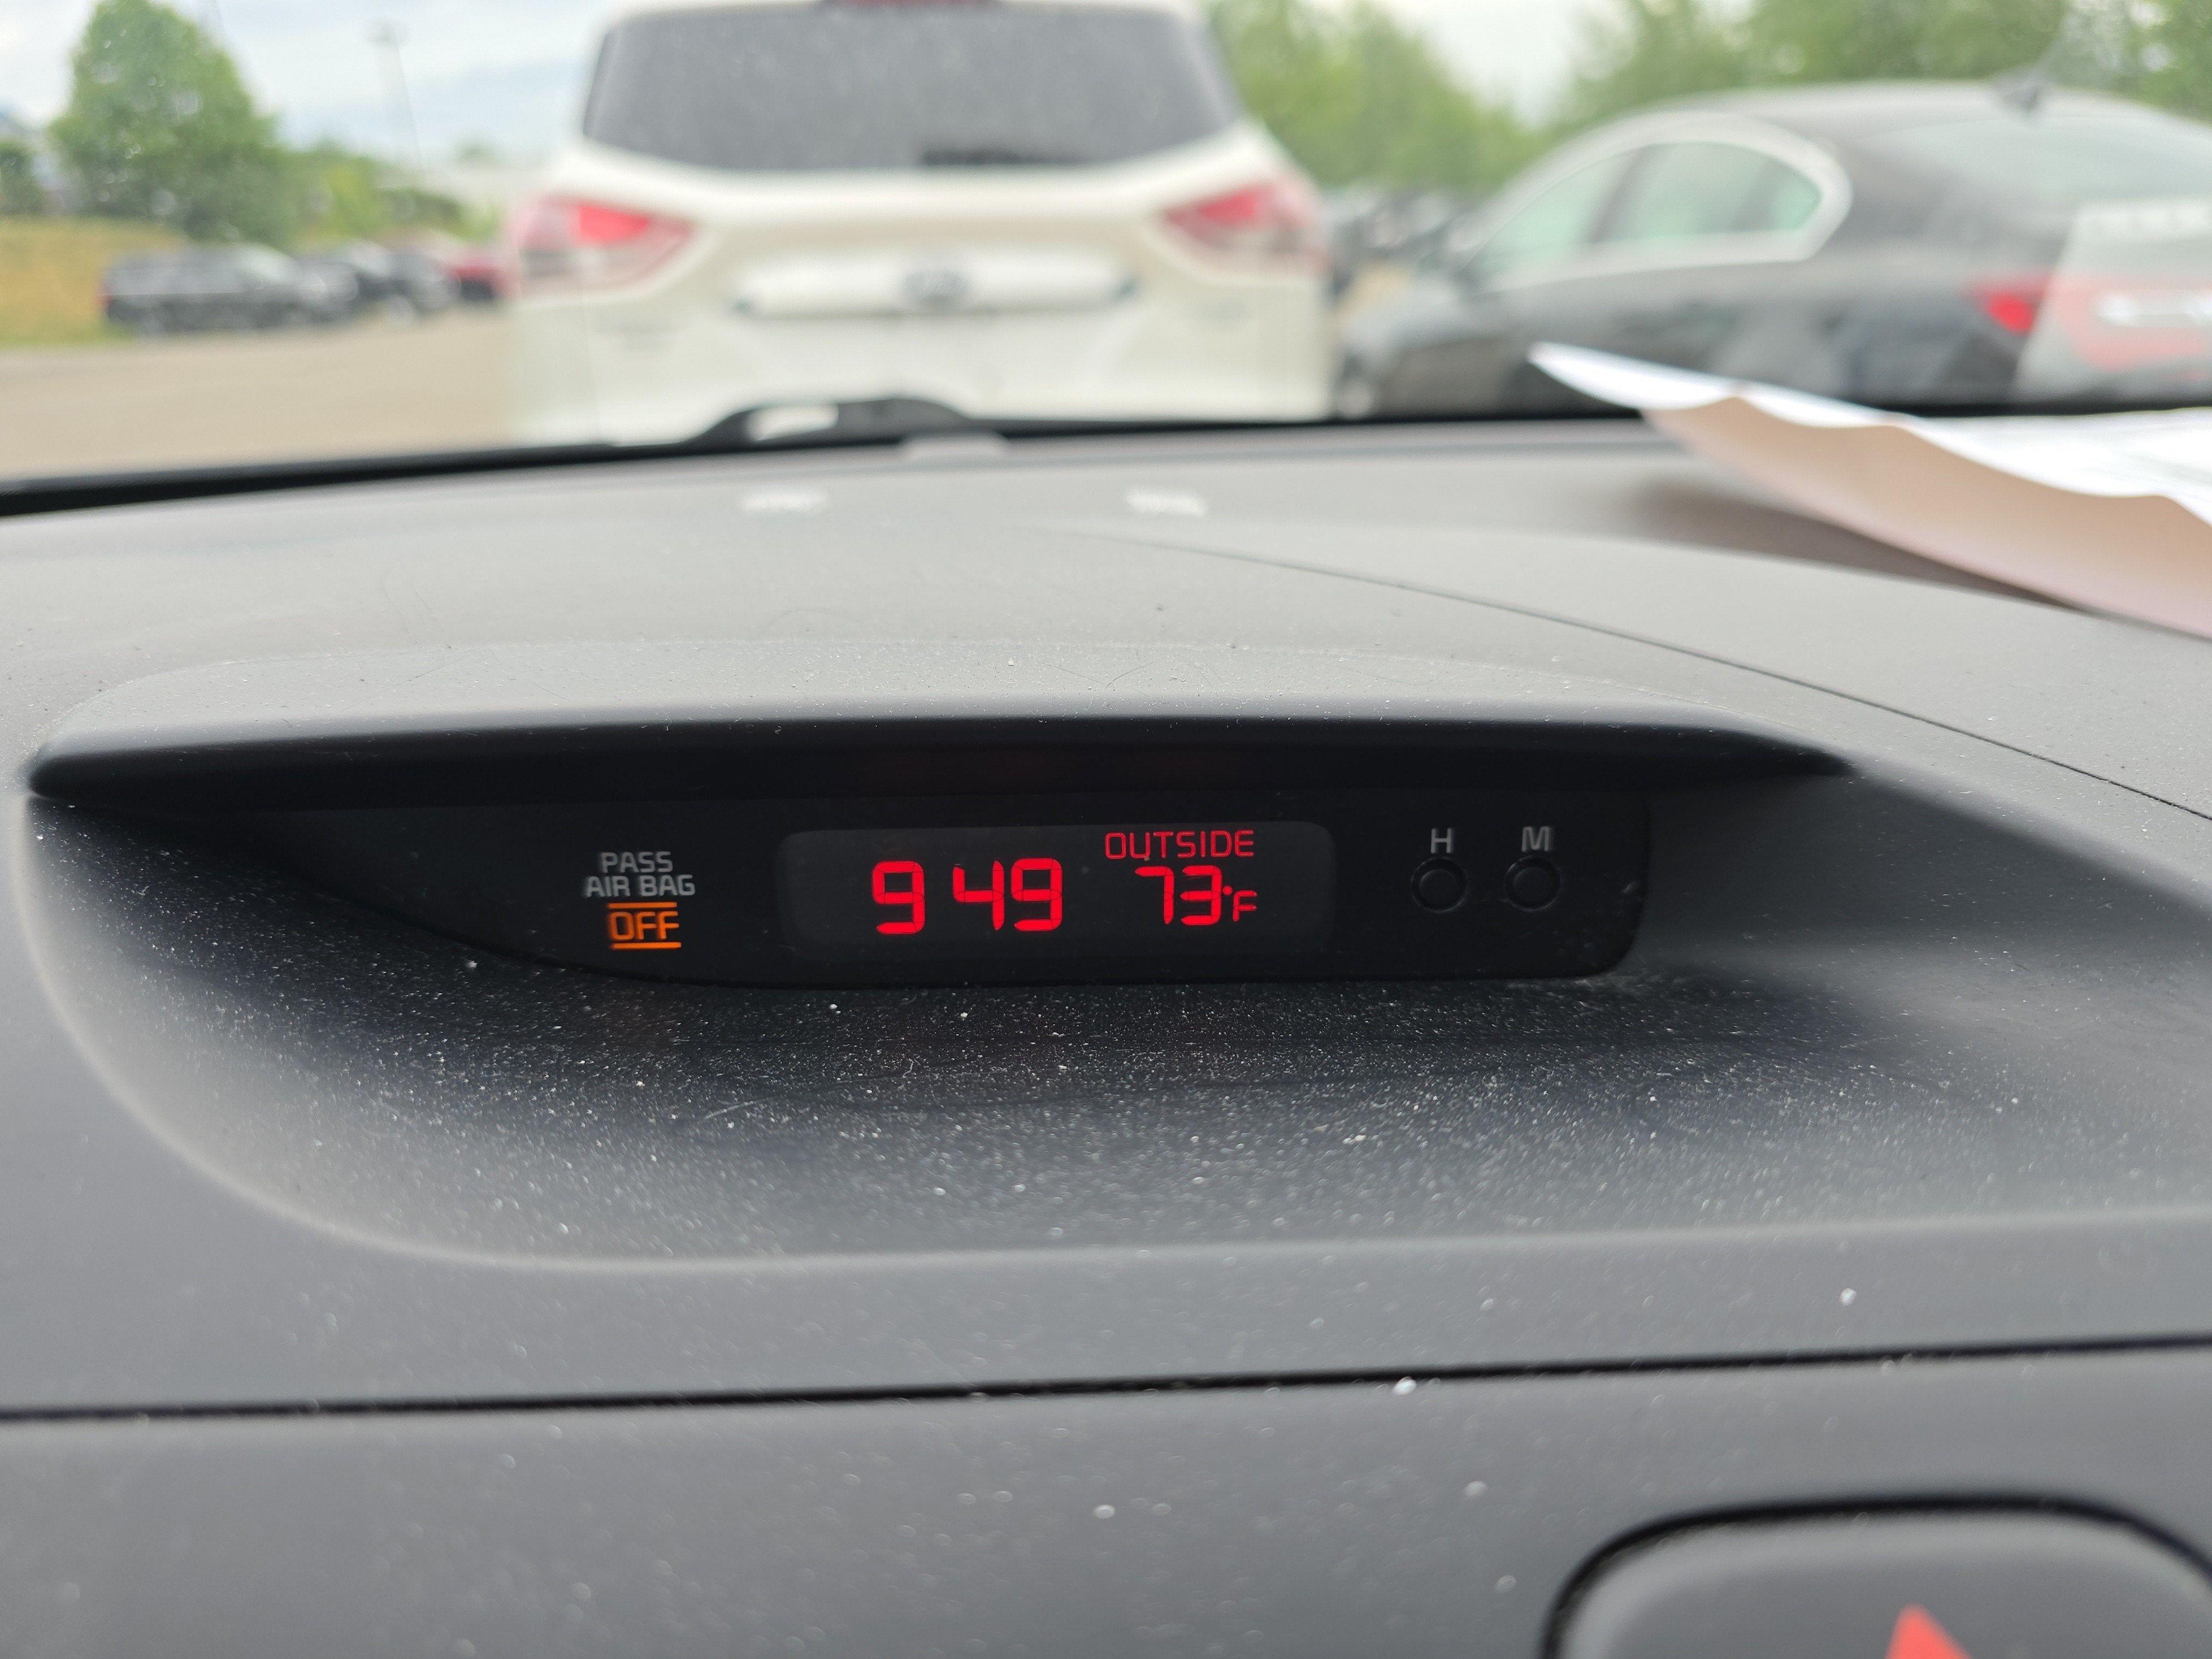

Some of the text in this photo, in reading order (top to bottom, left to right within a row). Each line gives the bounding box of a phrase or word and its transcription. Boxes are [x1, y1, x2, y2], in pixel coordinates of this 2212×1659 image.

[1104, 829, 1255, 860] OUTSIDE
[1430, 827, 1455, 854] H
[1521, 825, 1553, 853] M
[598, 851, 673, 873] PASS
[582, 873, 696, 898] AIR BAG
[607, 910, 680, 941] OFF
